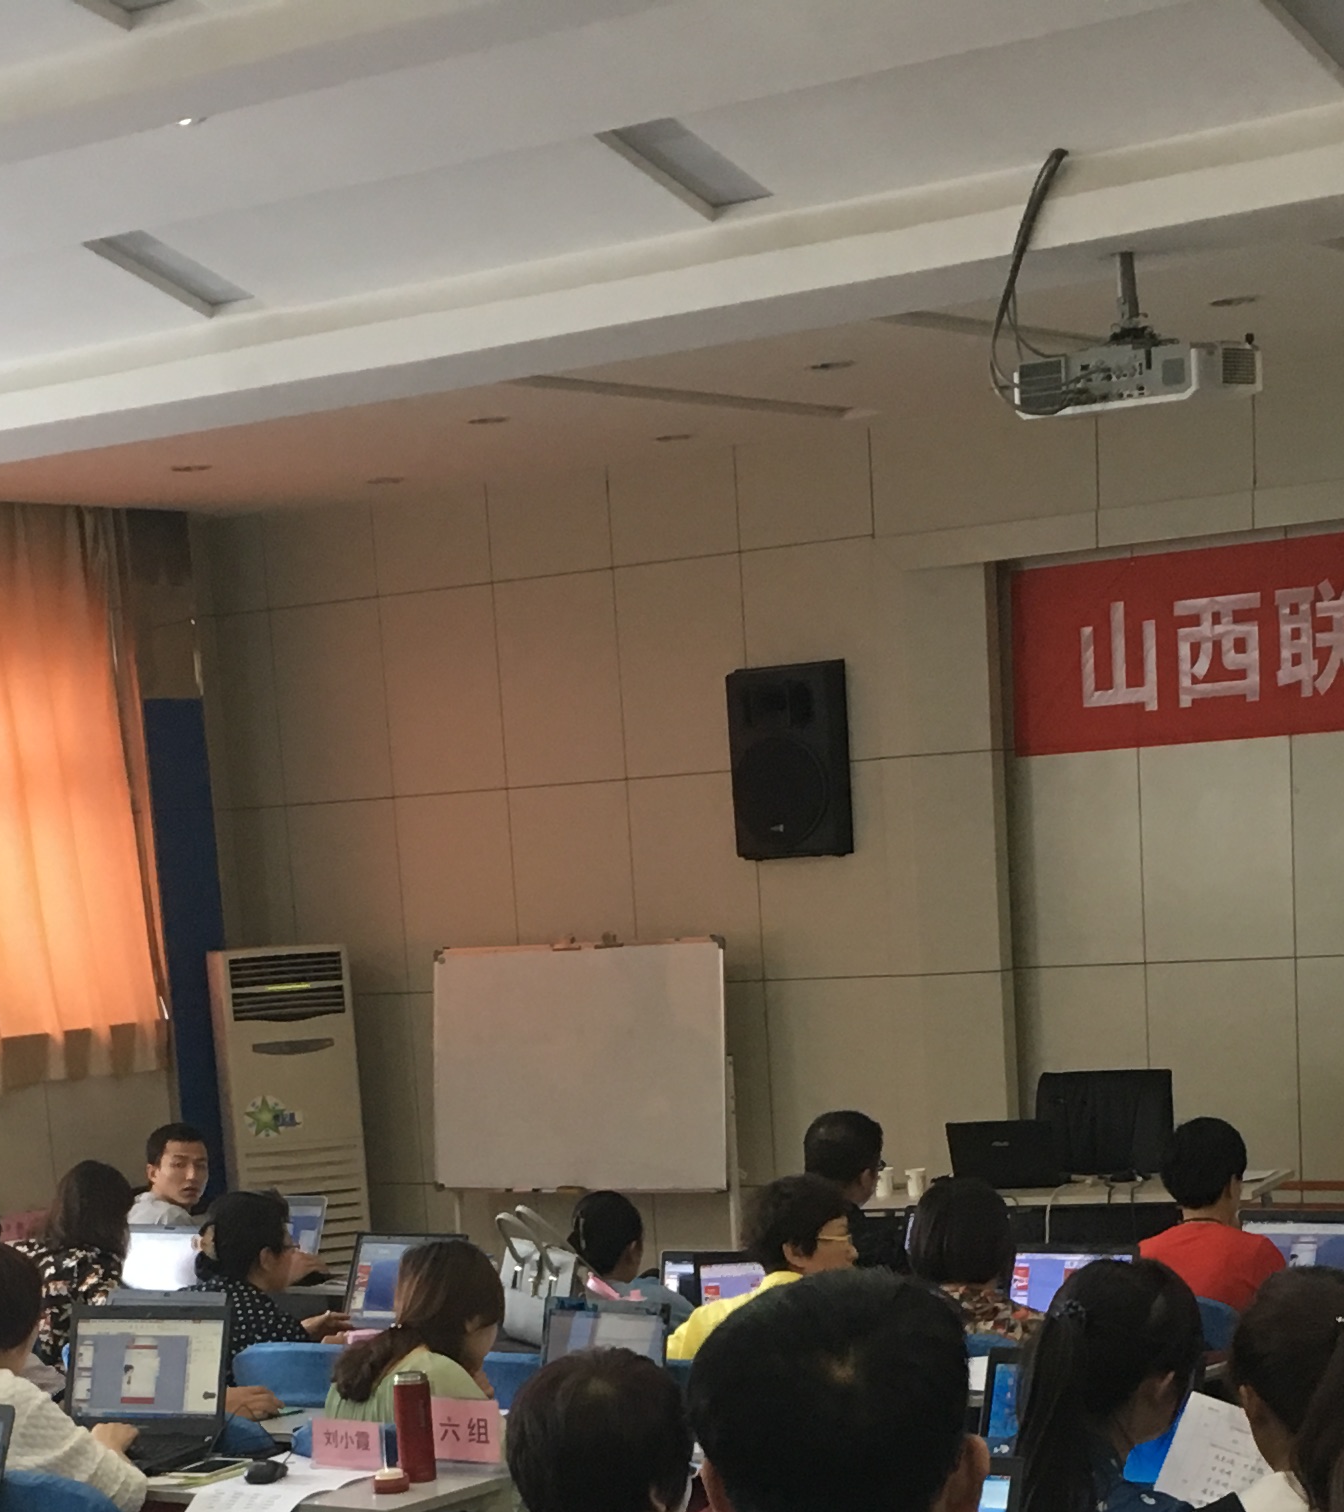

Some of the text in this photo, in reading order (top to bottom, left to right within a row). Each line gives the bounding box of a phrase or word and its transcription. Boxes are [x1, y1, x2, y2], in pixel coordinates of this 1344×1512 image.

[323, 1428, 371, 1451] 刘小霞
[439, 1416, 490, 1444] 六组
